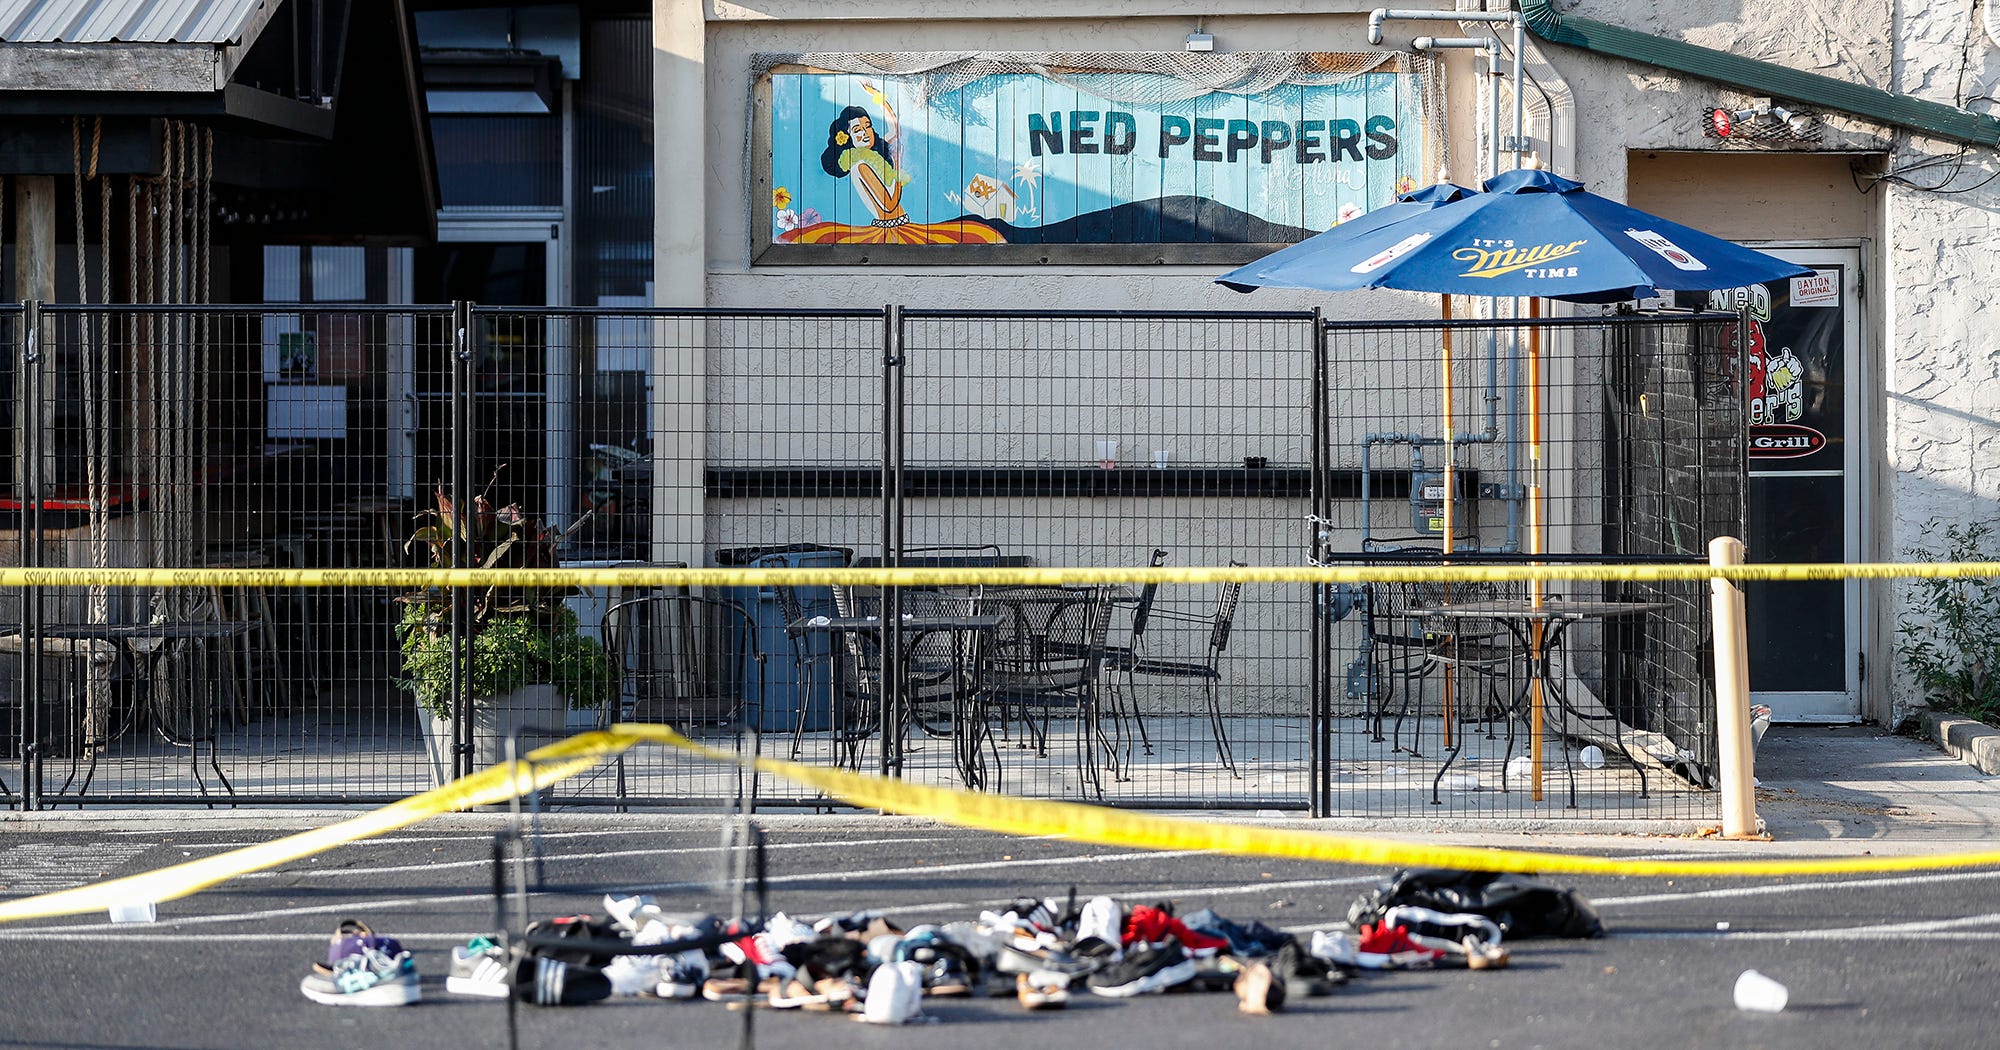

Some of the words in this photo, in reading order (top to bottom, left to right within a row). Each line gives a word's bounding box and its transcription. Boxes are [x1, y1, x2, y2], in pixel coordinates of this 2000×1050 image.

[1028, 111, 1137, 157] NED
[1158, 113, 1399, 164] PEPPERS
[1472, 238, 1514, 248] IT'S
[1452, 239, 1588, 275] Miller
[1524, 267, 1578, 278] TIME
[1797, 276, 1830, 290] DAYTON
[1799, 286, 1831, 296] ORIGINAL
[1754, 436, 1810, 448] Grill
